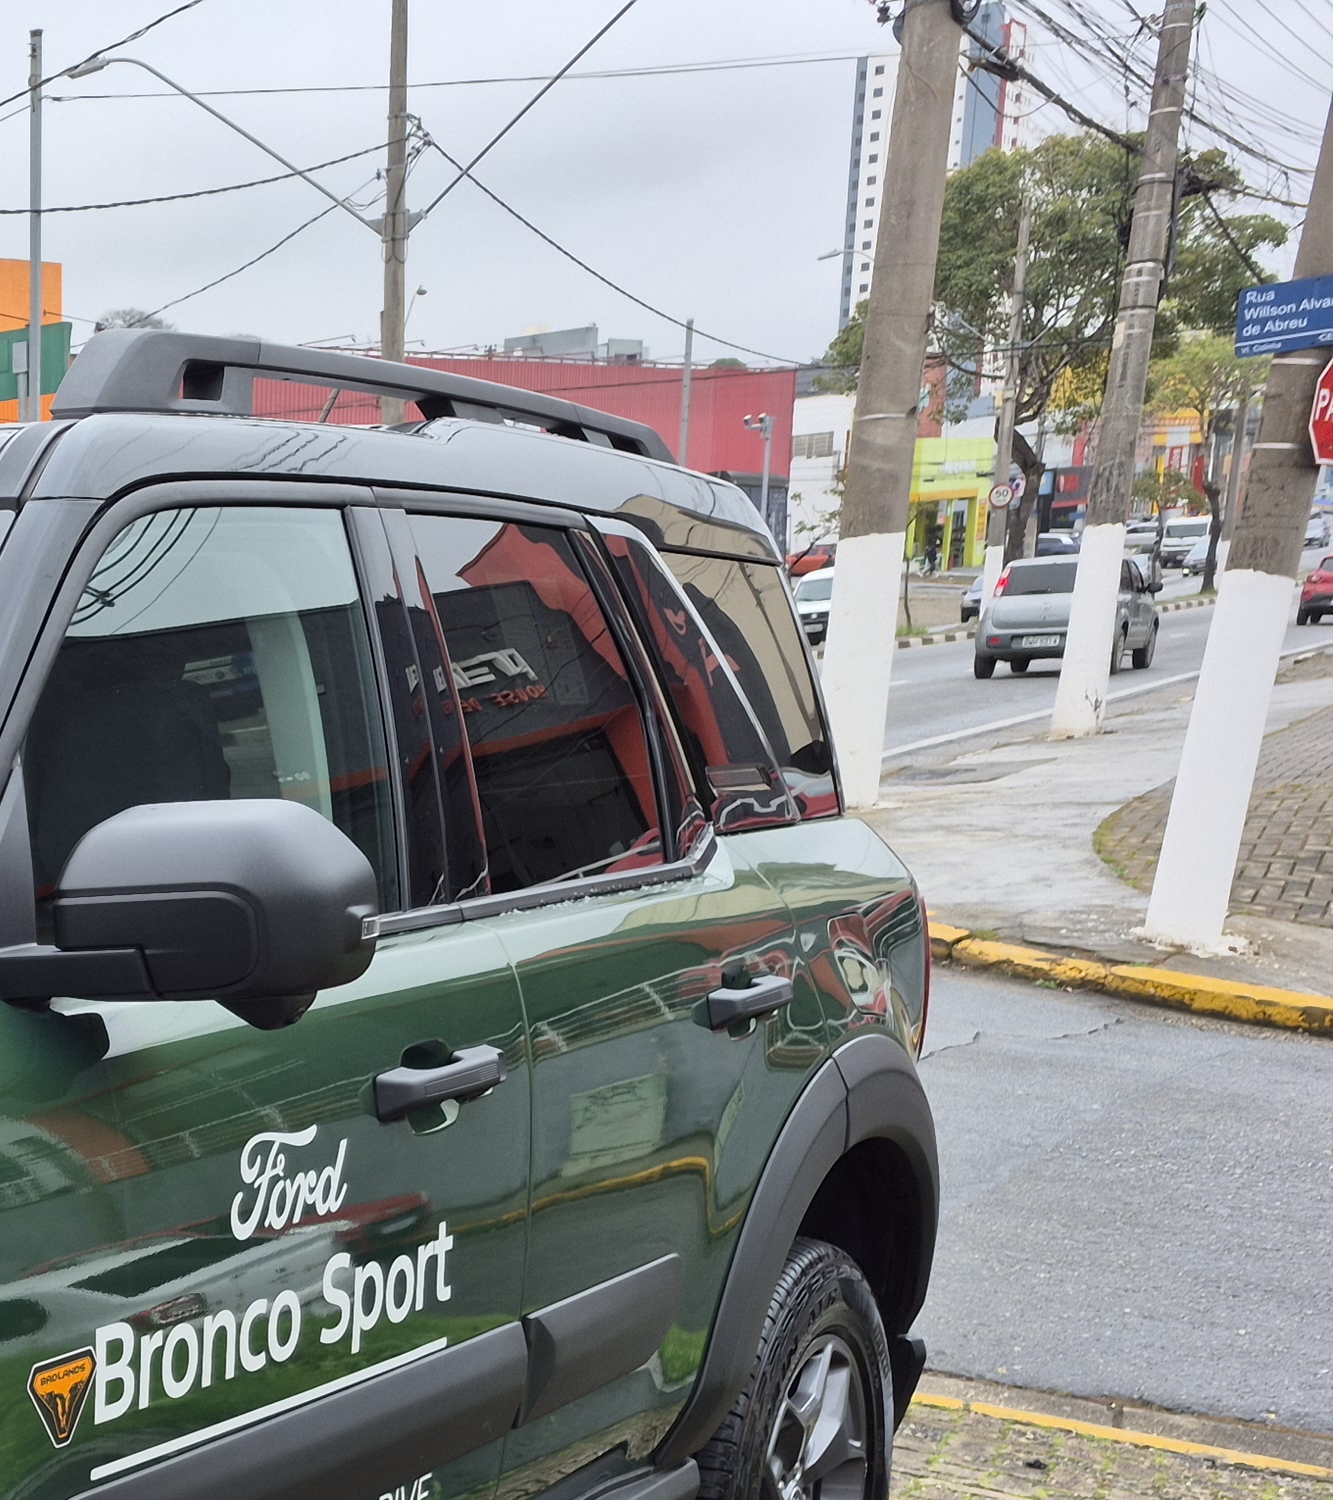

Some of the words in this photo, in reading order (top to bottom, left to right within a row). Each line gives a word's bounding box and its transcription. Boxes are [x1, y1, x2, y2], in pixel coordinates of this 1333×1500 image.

[1245, 289, 1275, 304] Rua
[1244, 302, 1296, 321] Willson
[1242, 323, 1261, 337] de
[1263, 317, 1308, 333] Abreu
[995, 488, 1009, 498] 50
[230, 1123, 348, 1241] Ford
[93, 1289, 302, 1426] Bronco
[319, 1220, 455, 1356] Sport
[40, 1363, 86, 1386] BADLANDS
